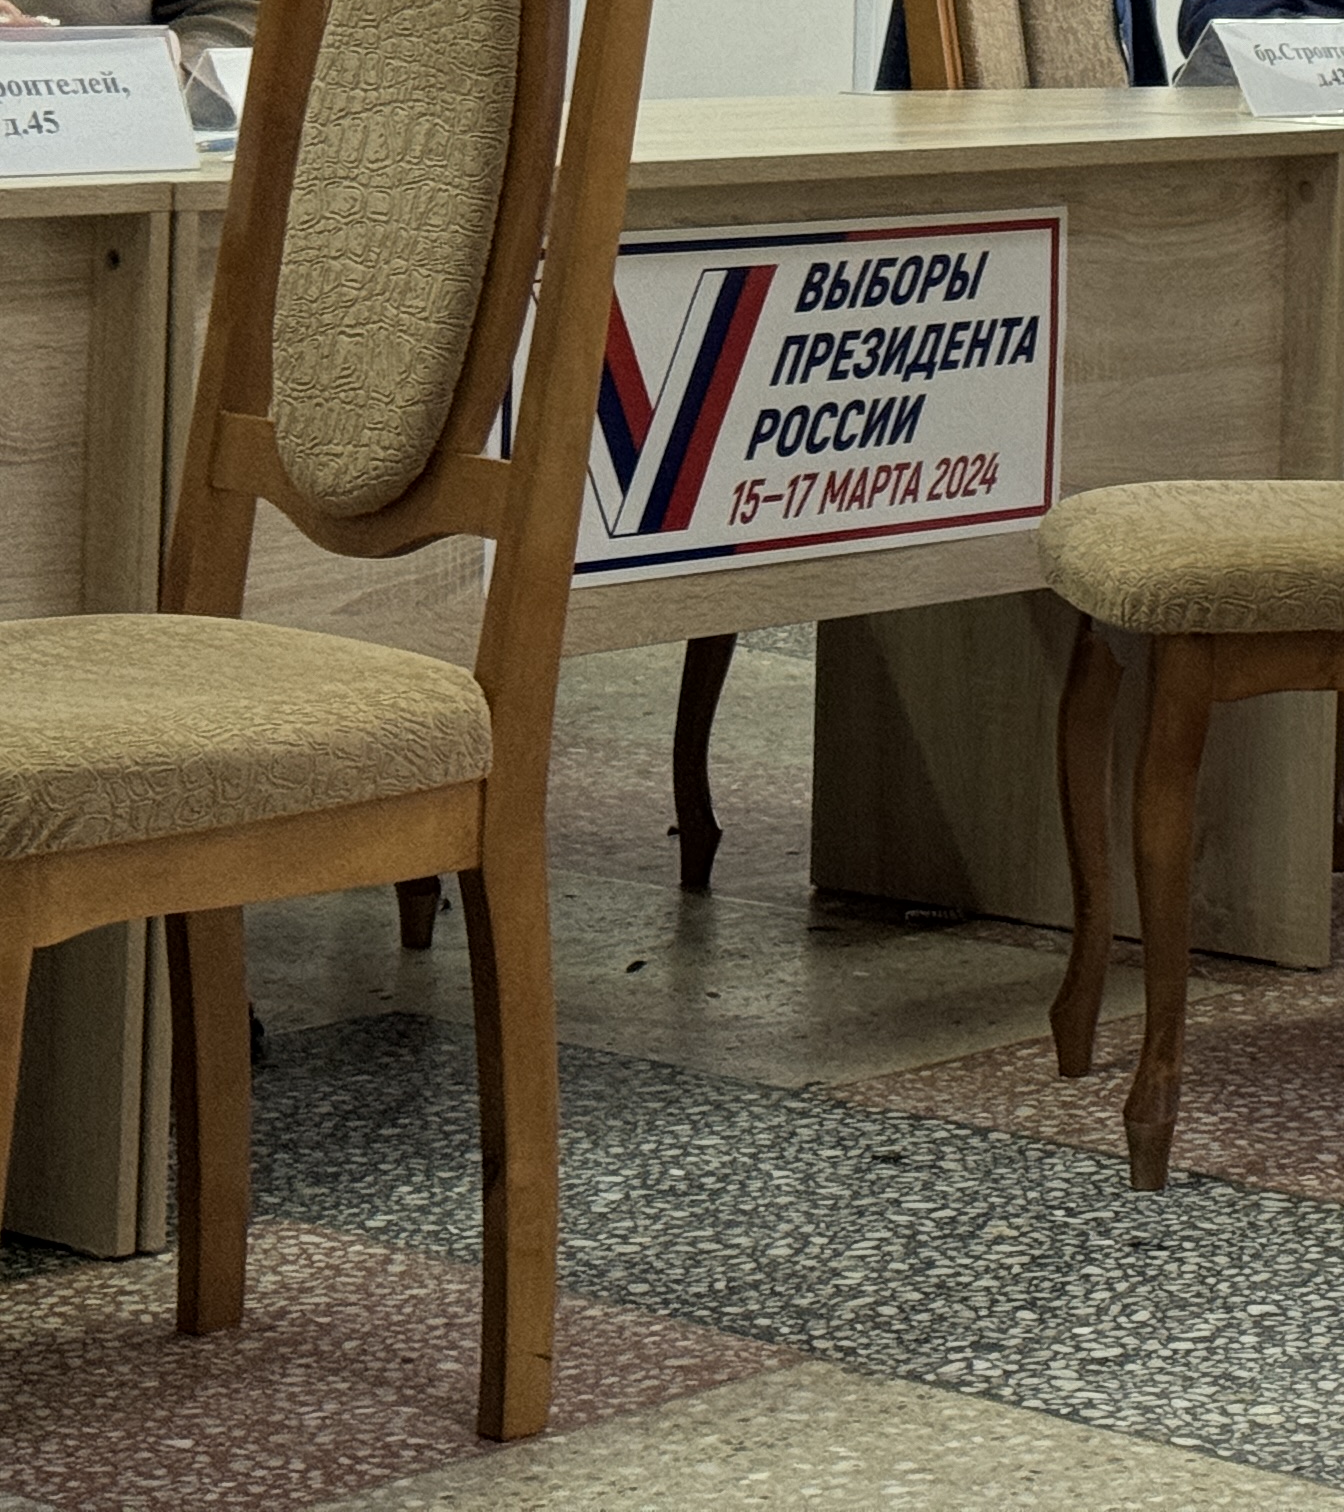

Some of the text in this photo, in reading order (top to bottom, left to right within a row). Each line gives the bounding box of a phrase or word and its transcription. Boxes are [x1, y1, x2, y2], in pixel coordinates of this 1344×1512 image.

[2, 110, 61, 138] д.45
[795, 251, 990, 313] ВЫБОРЫ
[769, 315, 1041, 387] ПРЕЗИДЕНТА
[744, 393, 927, 462] РОССИИ
[817, 461, 924, 515] МАРТА
[926, 453, 999, 503] 2024
